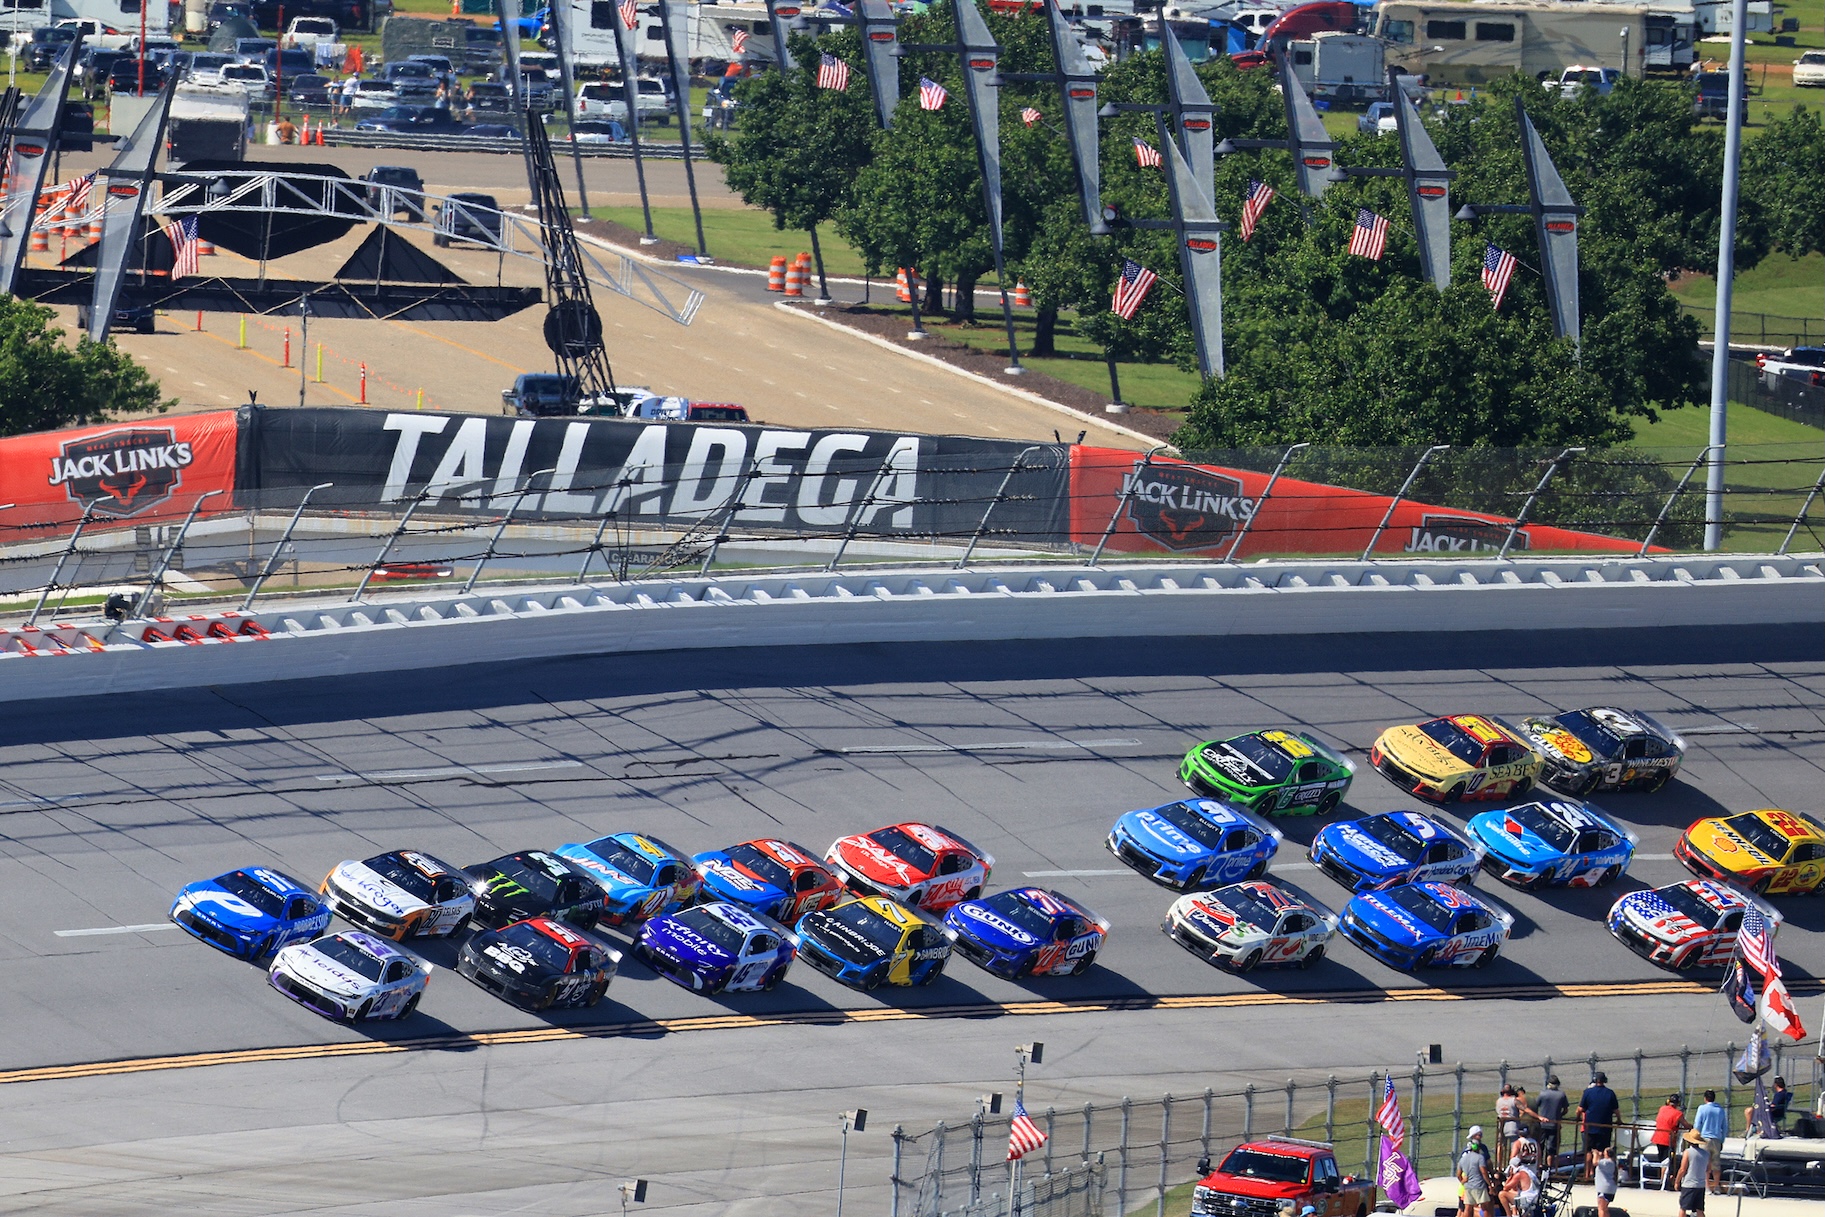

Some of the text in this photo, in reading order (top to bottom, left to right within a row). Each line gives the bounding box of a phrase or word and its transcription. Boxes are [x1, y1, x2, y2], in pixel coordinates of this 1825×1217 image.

[49, 443, 192, 484] JACK LINK'S
[380, 413, 921, 529] TALLADEGA
[1116, 474, 1253, 520] JACK LINK'S
[1405, 527, 1466, 552] JACK
[1530, 734, 1565, 760] CLUB
[1489, 766, 1511, 780] SEA
[1604, 763, 1623, 784] 3
[1199, 817, 1220, 833] ELLIOTT
[1403, 812, 1436, 839] 5
[1550, 802, 1594, 828] 24
[1136, 811, 1202, 854] prime
[1401, 830, 1421, 845] LARSON
[1708, 820, 1772, 866] PENNZOIL
[1769, 829, 1788, 843] LOGANO
[1203, 854, 1228, 881] 9
[1226, 854, 1250, 869] prime
[1554, 858, 1580, 879] 24
[1770, 868, 1799, 889] 22
[261, 885, 284, 901] HAMLIN
[357, 880, 405, 916] Kroger
[795, 891, 826, 914] NOS
[919, 884, 945, 905] 54
[1700, 881, 1737, 907] 1
[777, 896, 796, 921] 47
[875, 899, 908, 923] 7
[883, 920, 903, 934] HALEY
[962, 904, 1029, 942] GUNK
[271, 929, 291, 950] 11
[661, 928, 708, 956] mobile
[826, 917, 886, 957] GAINBRIDGE
[1261, 936, 1290, 961] 77
[483, 945, 527, 975] BBQ
[1037, 944, 1060, 967] 71
[1439, 939, 1463, 961] 38
[313, 958, 361, 991] leidos
[732, 961, 754, 984] 45
[886, 952, 908, 977] 7
